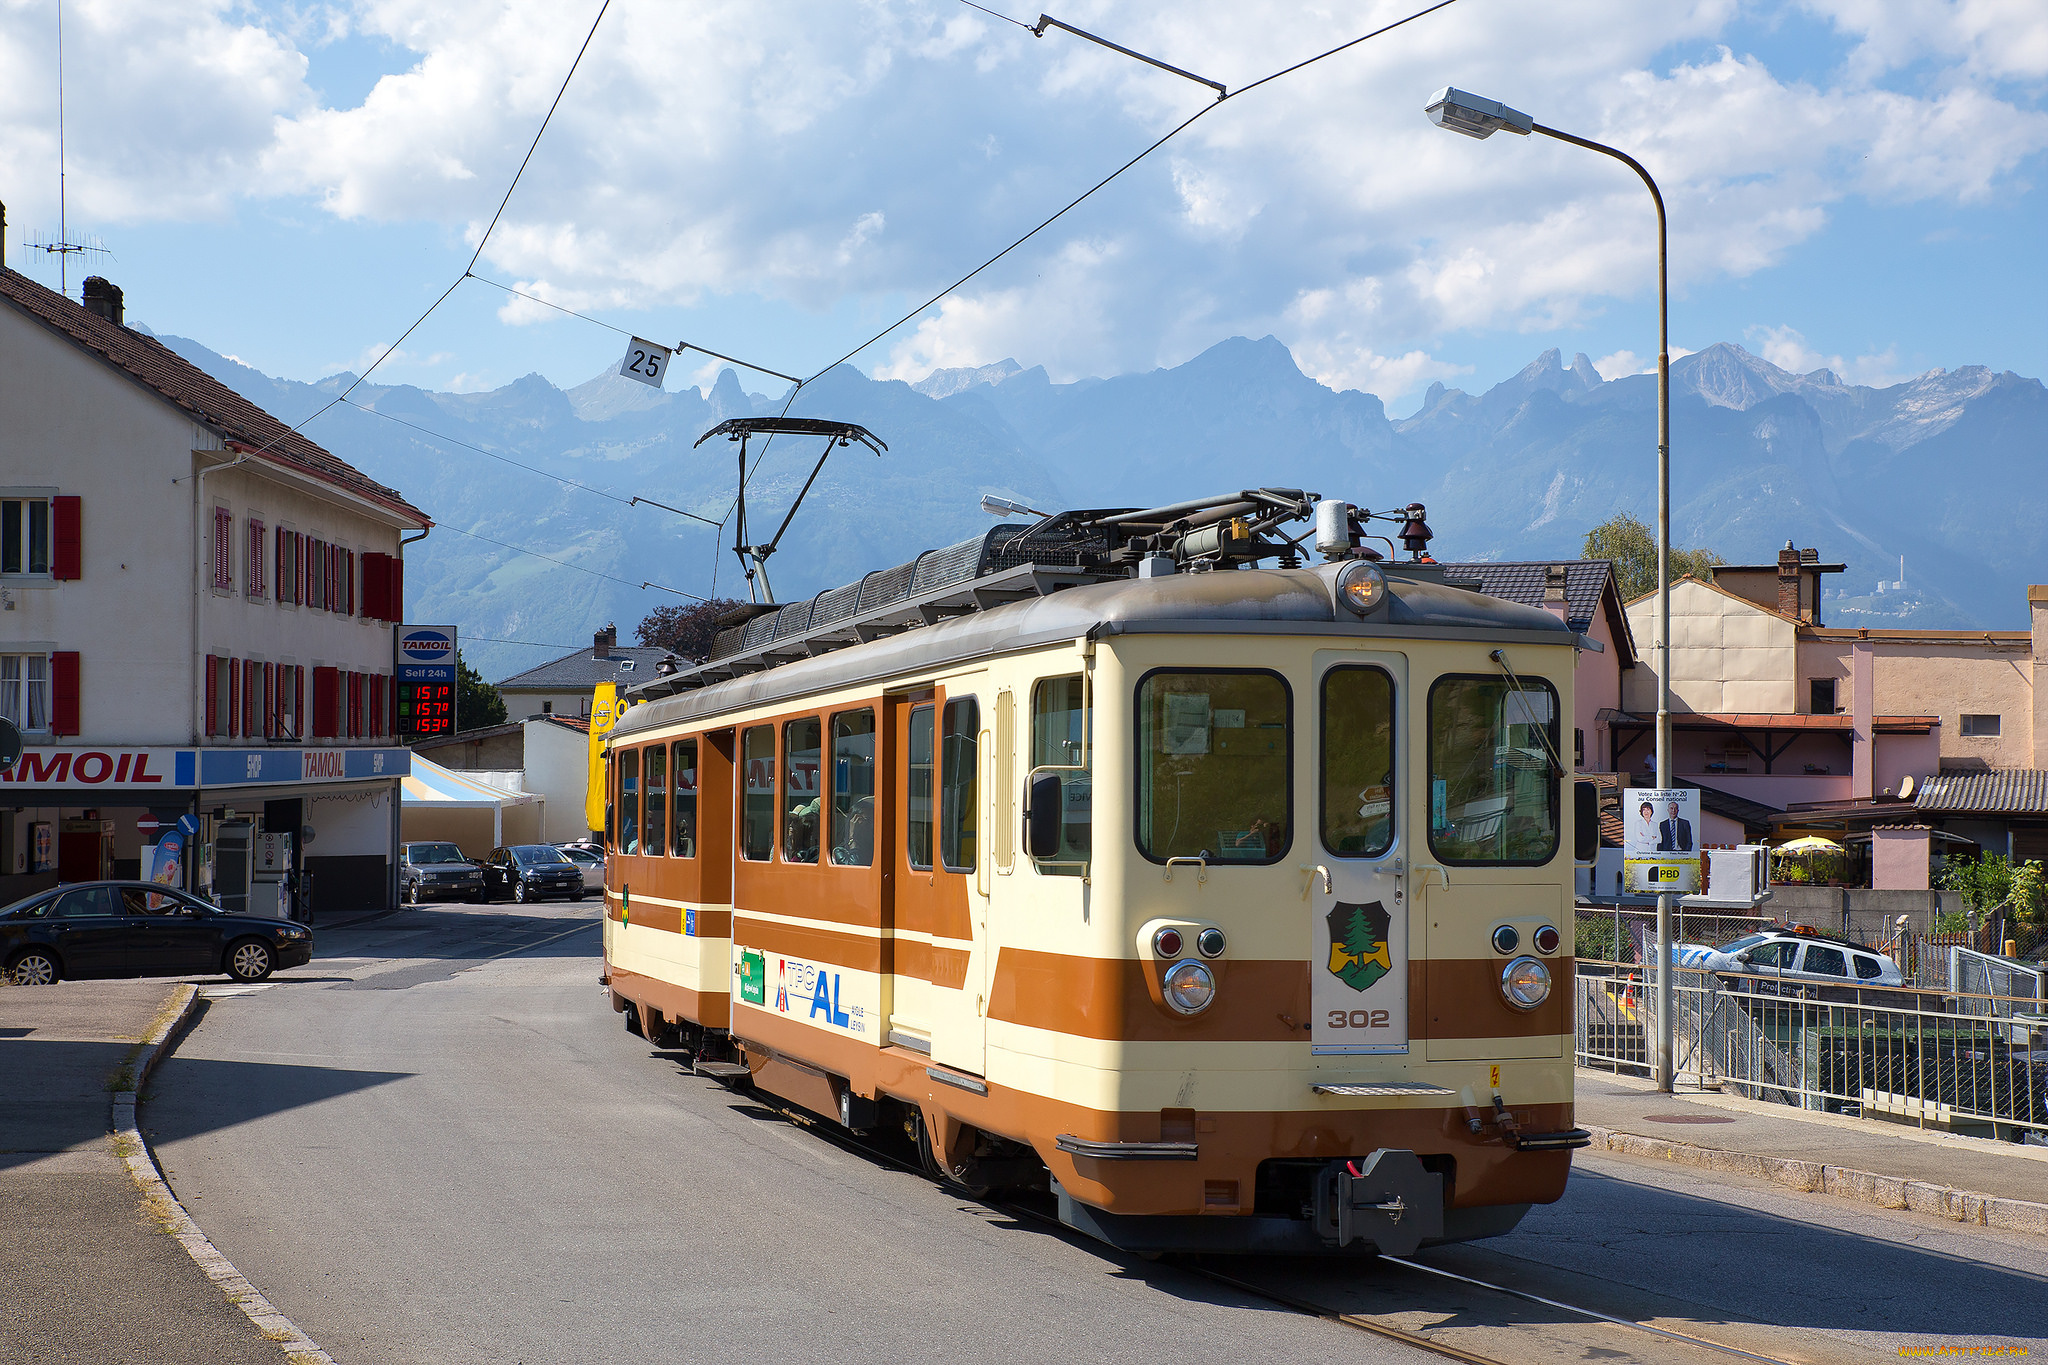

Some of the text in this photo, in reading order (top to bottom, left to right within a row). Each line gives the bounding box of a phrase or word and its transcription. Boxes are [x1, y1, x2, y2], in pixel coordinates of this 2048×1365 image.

[629, 350, 661, 377] 25
[402, 641, 451, 650] TAMOIL
[405, 669, 447, 678] Self 24h
[246, 754, 262, 779] SHOP
[304, 751, 343, 778] TAMOIL
[1660, 869, 1680, 879] PBD
[787, 961, 849, 1028] TPC AL
[1327, 1009, 1390, 1029] 302
